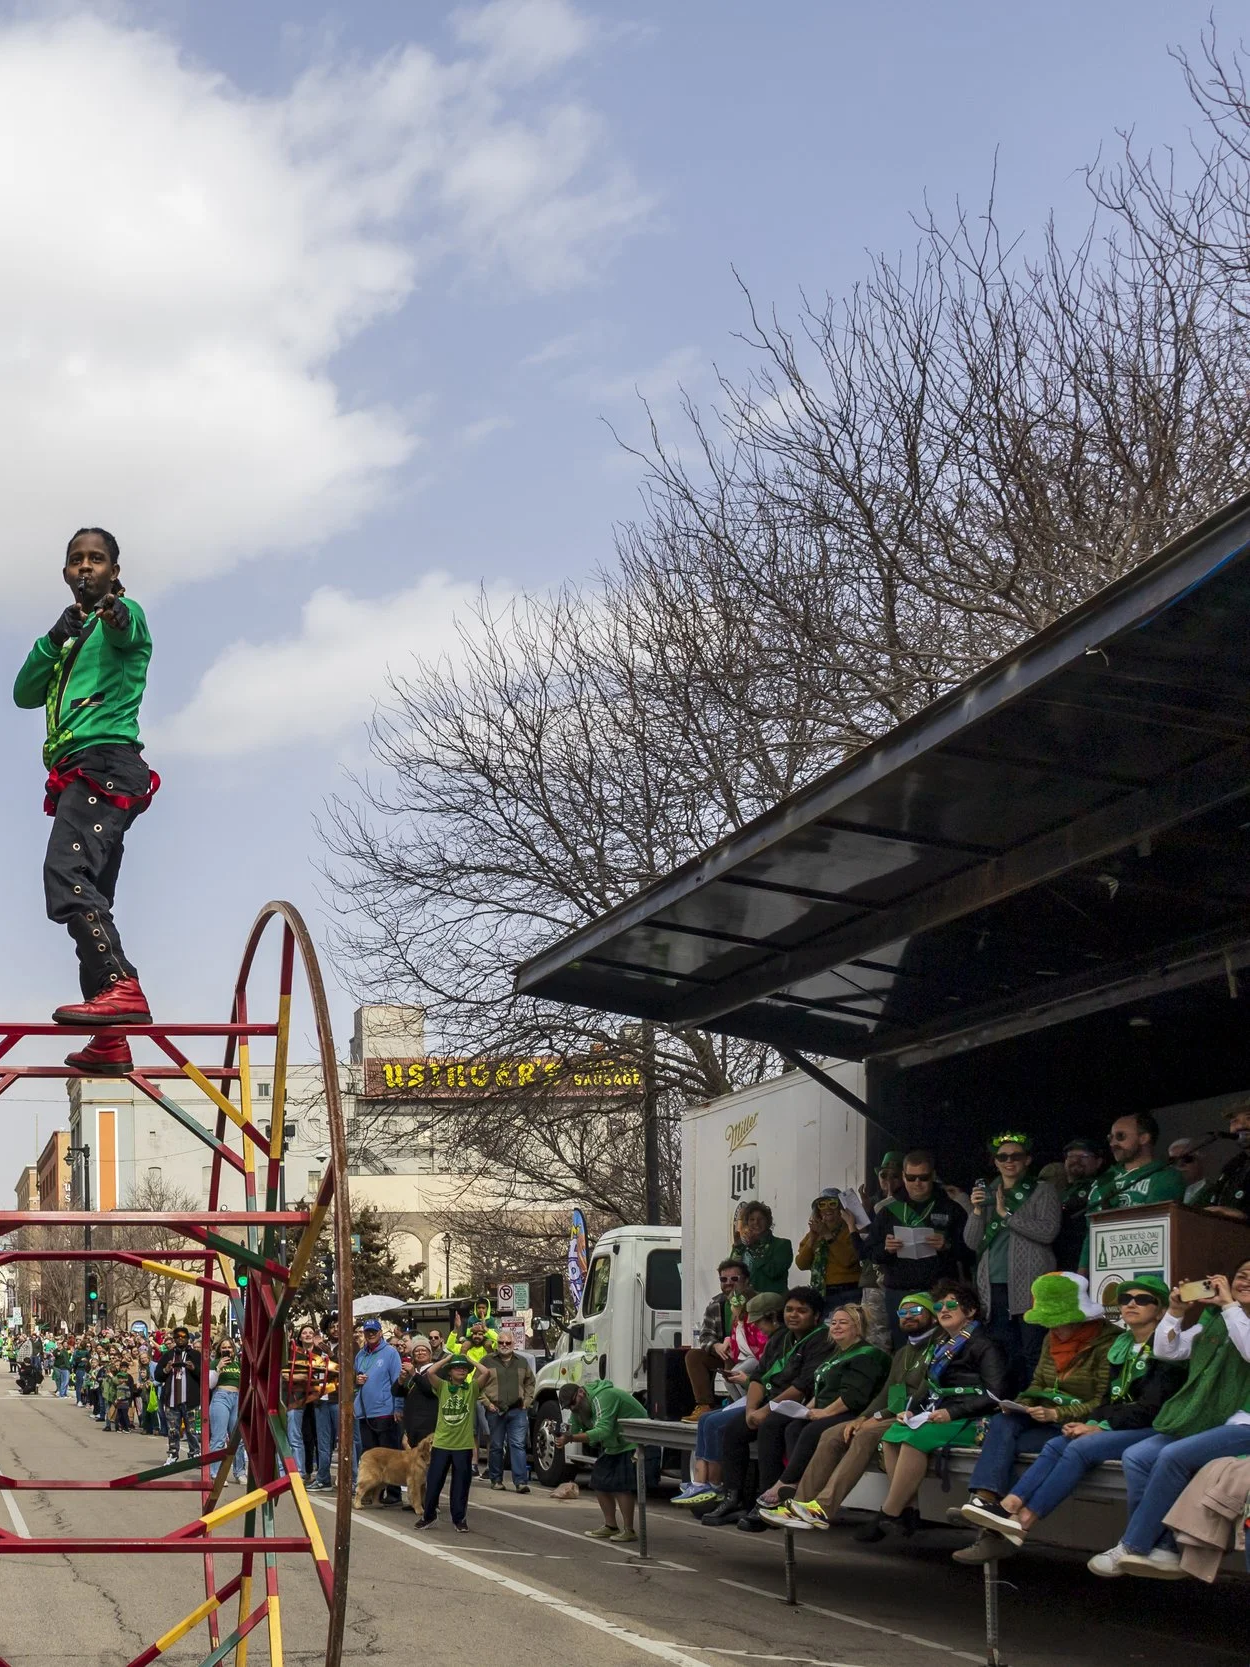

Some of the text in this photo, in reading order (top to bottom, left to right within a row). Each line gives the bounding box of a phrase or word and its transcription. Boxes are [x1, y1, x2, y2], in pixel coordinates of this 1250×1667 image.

[573, 1073, 641, 1086] SAUSAGE
[725, 1112, 759, 1158] Miller
[730, 1162, 756, 1201] Lite
[1110, 1241, 1159, 1261] PARADE
